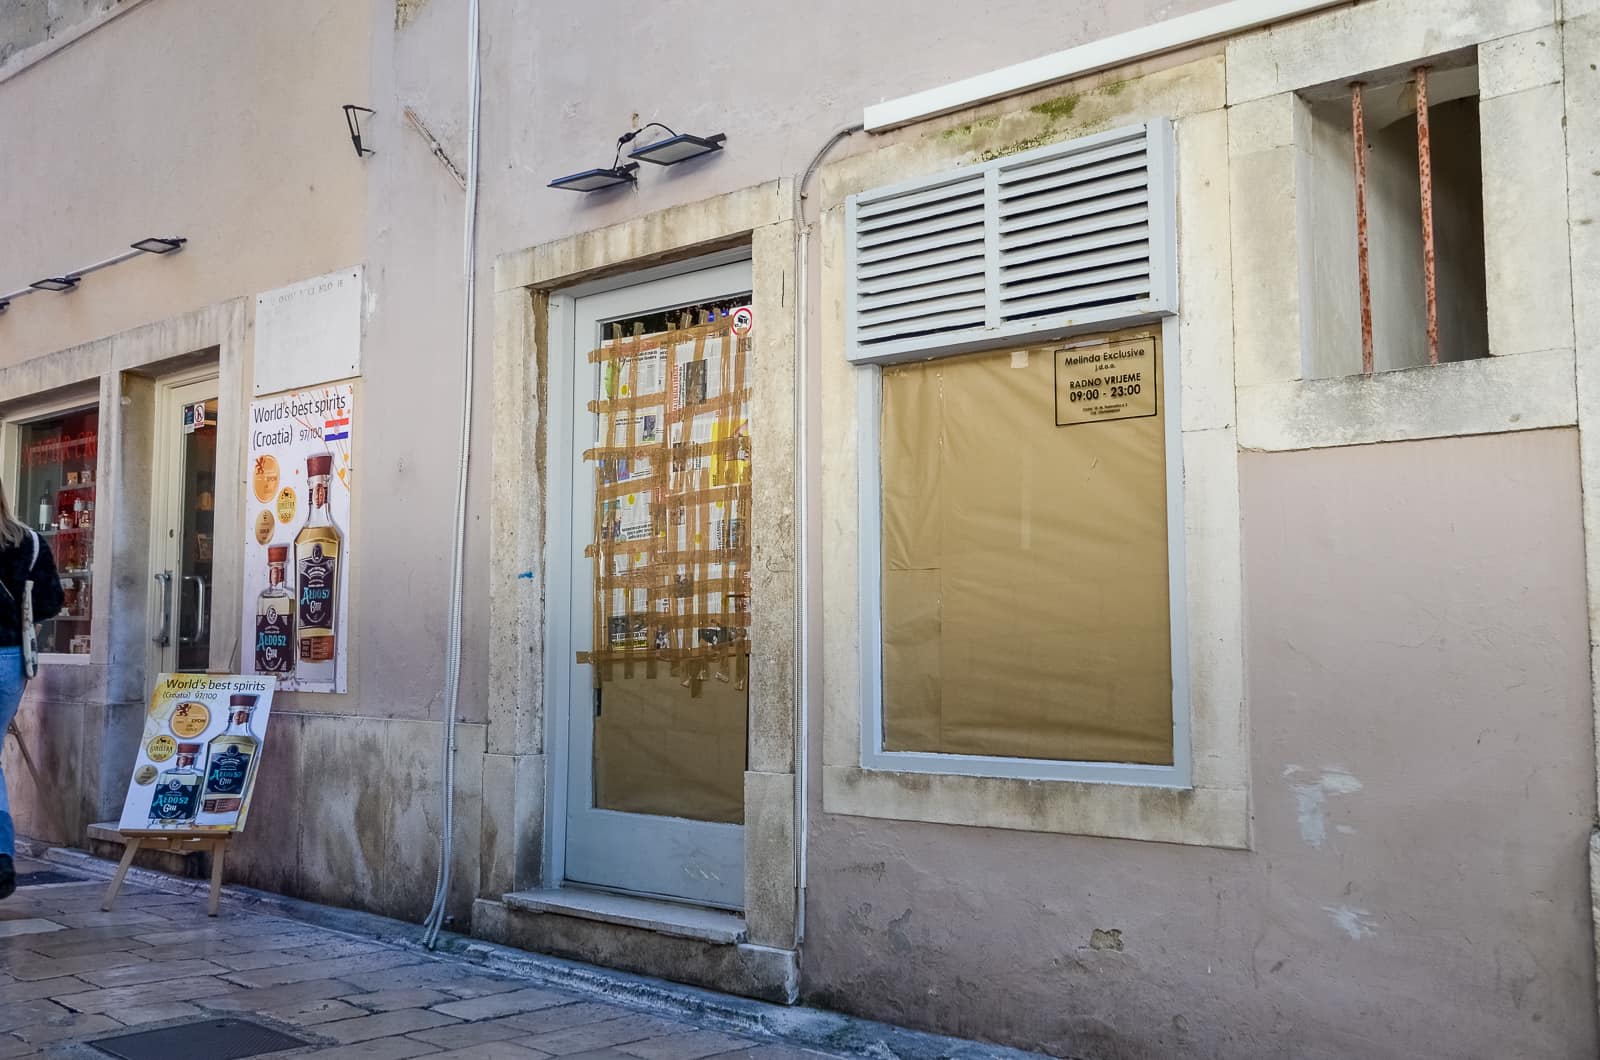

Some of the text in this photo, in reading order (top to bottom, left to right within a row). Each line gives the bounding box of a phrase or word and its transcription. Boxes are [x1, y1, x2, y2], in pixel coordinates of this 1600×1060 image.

[1065, 347, 1145, 366] Melinda Exclusive
[1069, 372, 1141, 390] RADNO VRIJEME
[1069, 388, 1100, 403] 09:00
[1110, 383, 1141, 398] 23:00
[253, 393, 346, 424] World's best spirits
[253, 424, 323, 451] (Croatia) 97/100
[166, 679, 266, 692] World's best spirits
